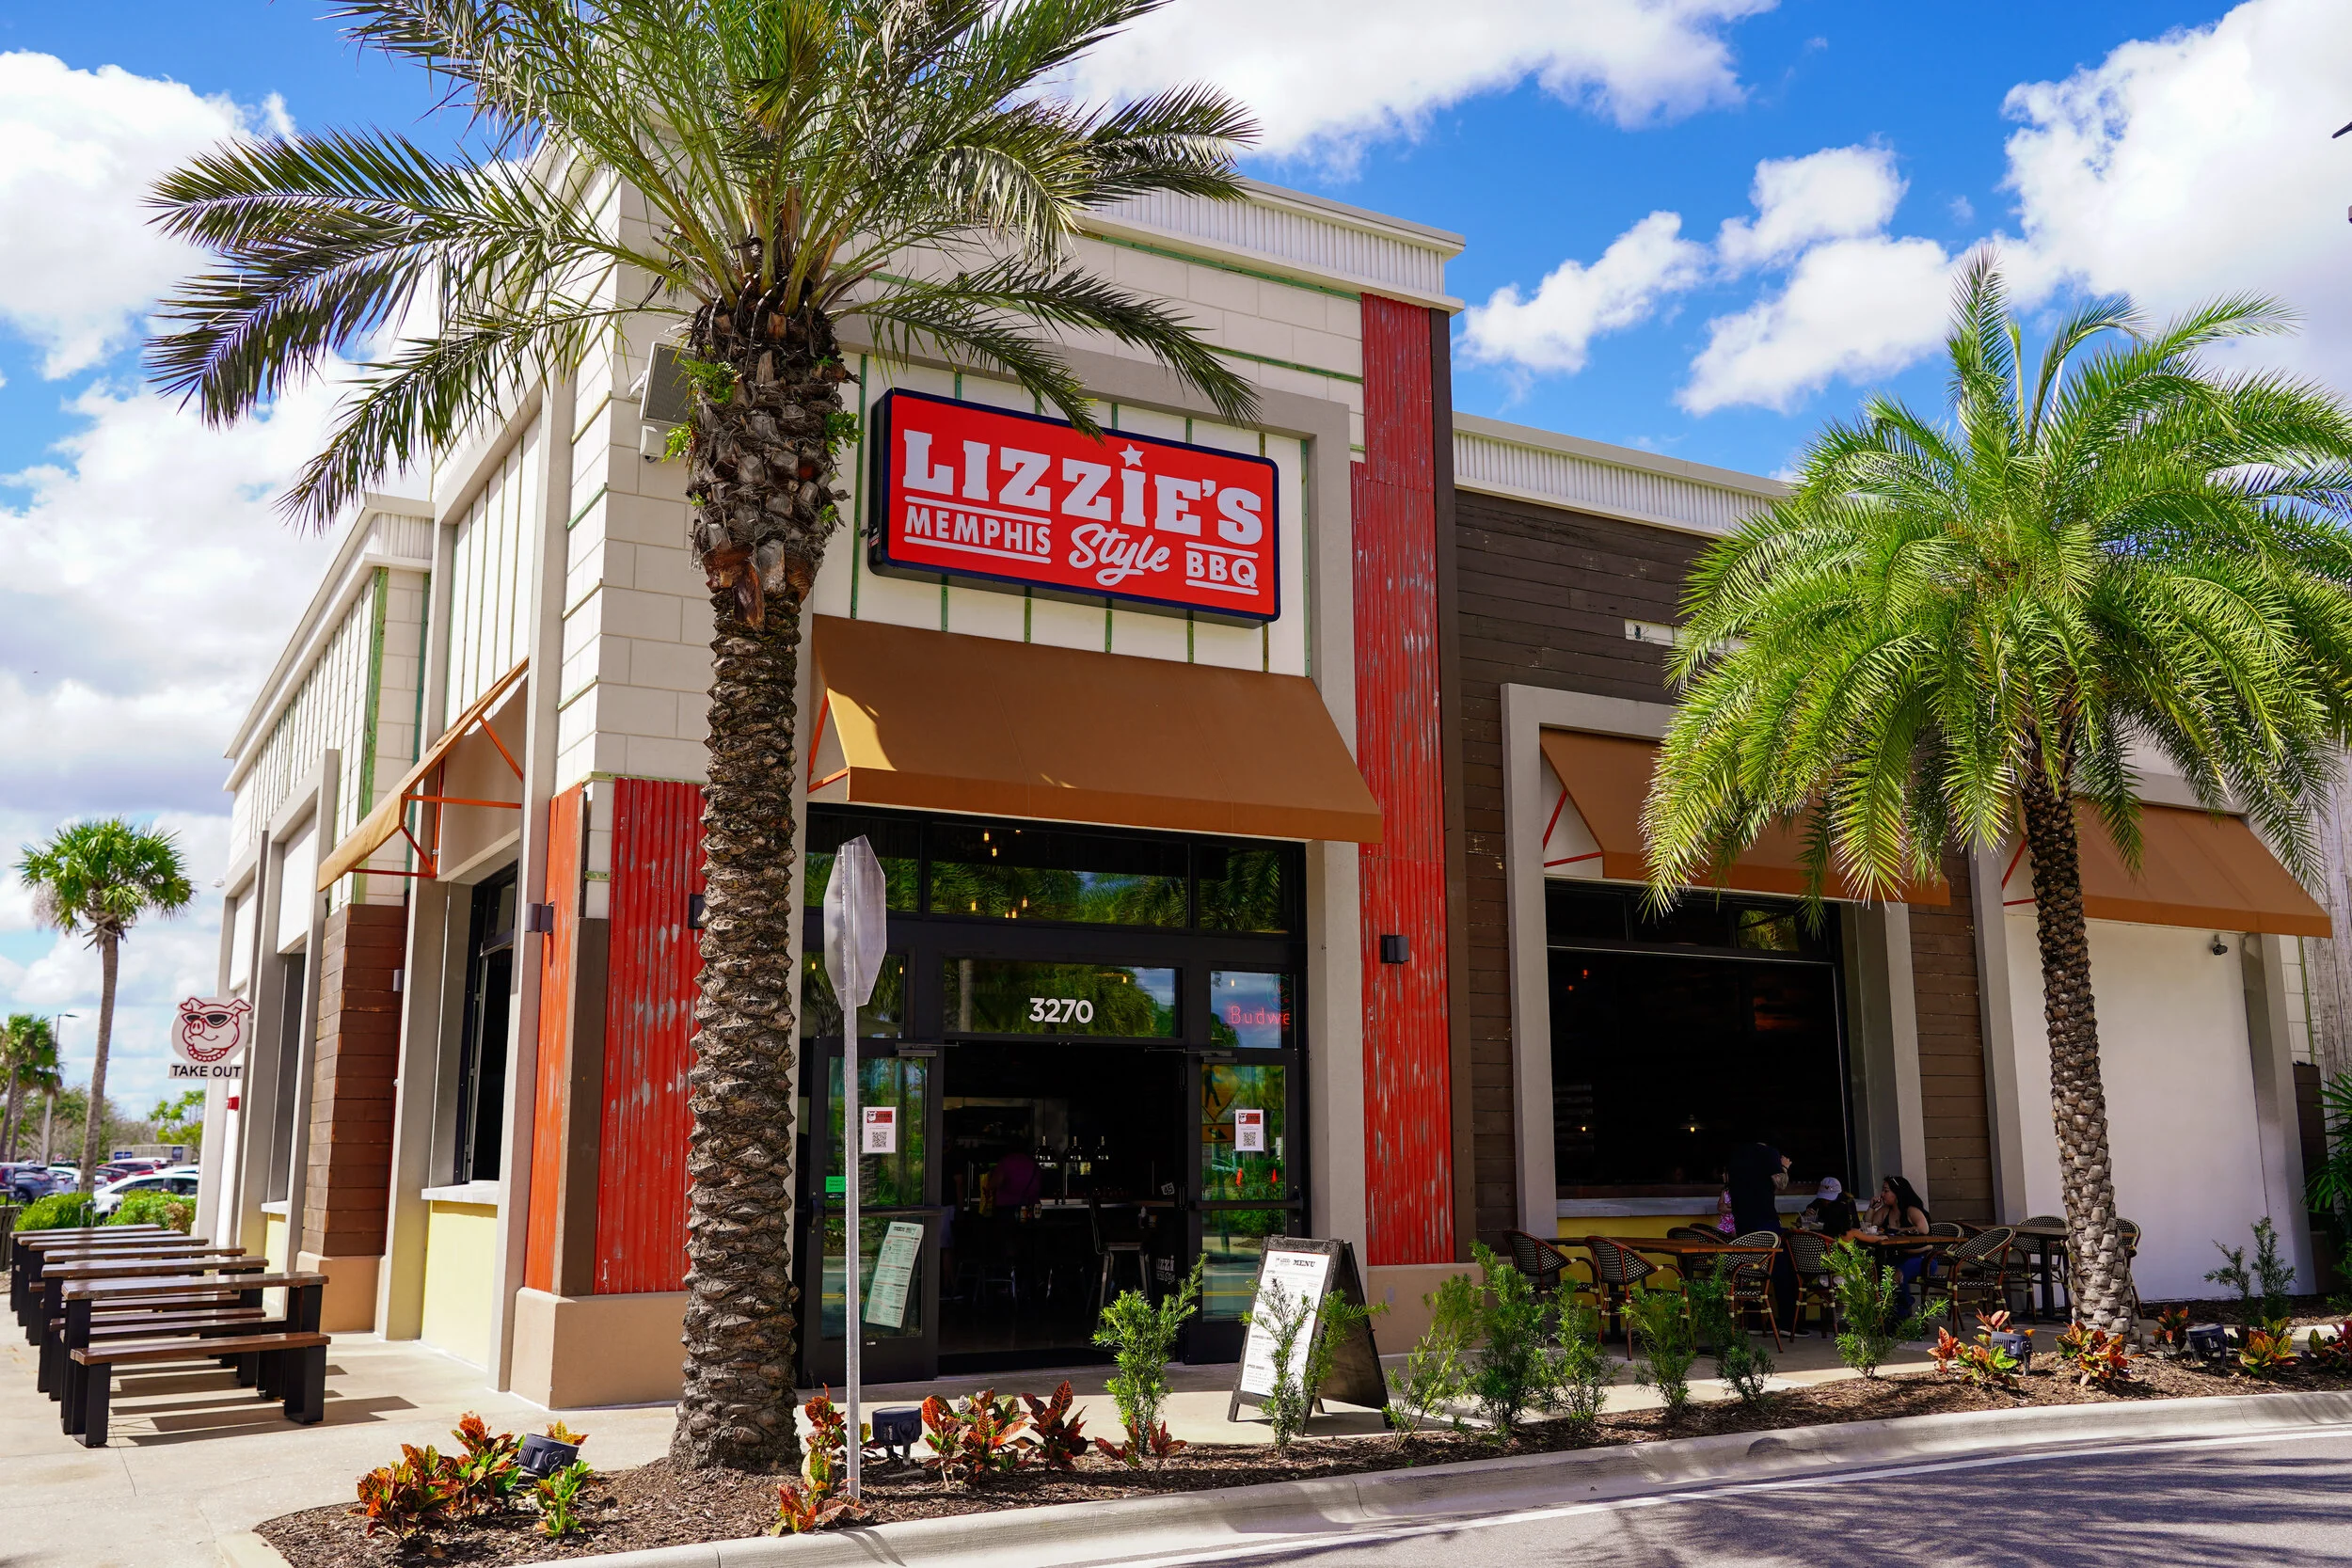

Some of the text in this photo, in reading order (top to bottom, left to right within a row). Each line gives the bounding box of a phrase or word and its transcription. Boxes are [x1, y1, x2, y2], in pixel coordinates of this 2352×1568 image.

[902, 429, 1263, 545] LIZZIE'S
[904, 505, 1257, 588] MEMPHIS Style BBQ
[1028, 997, 1094, 1023] 3270
[172, 1065, 242, 1078] TAKE OUT
[1293, 1259, 1316, 1268] MENU
